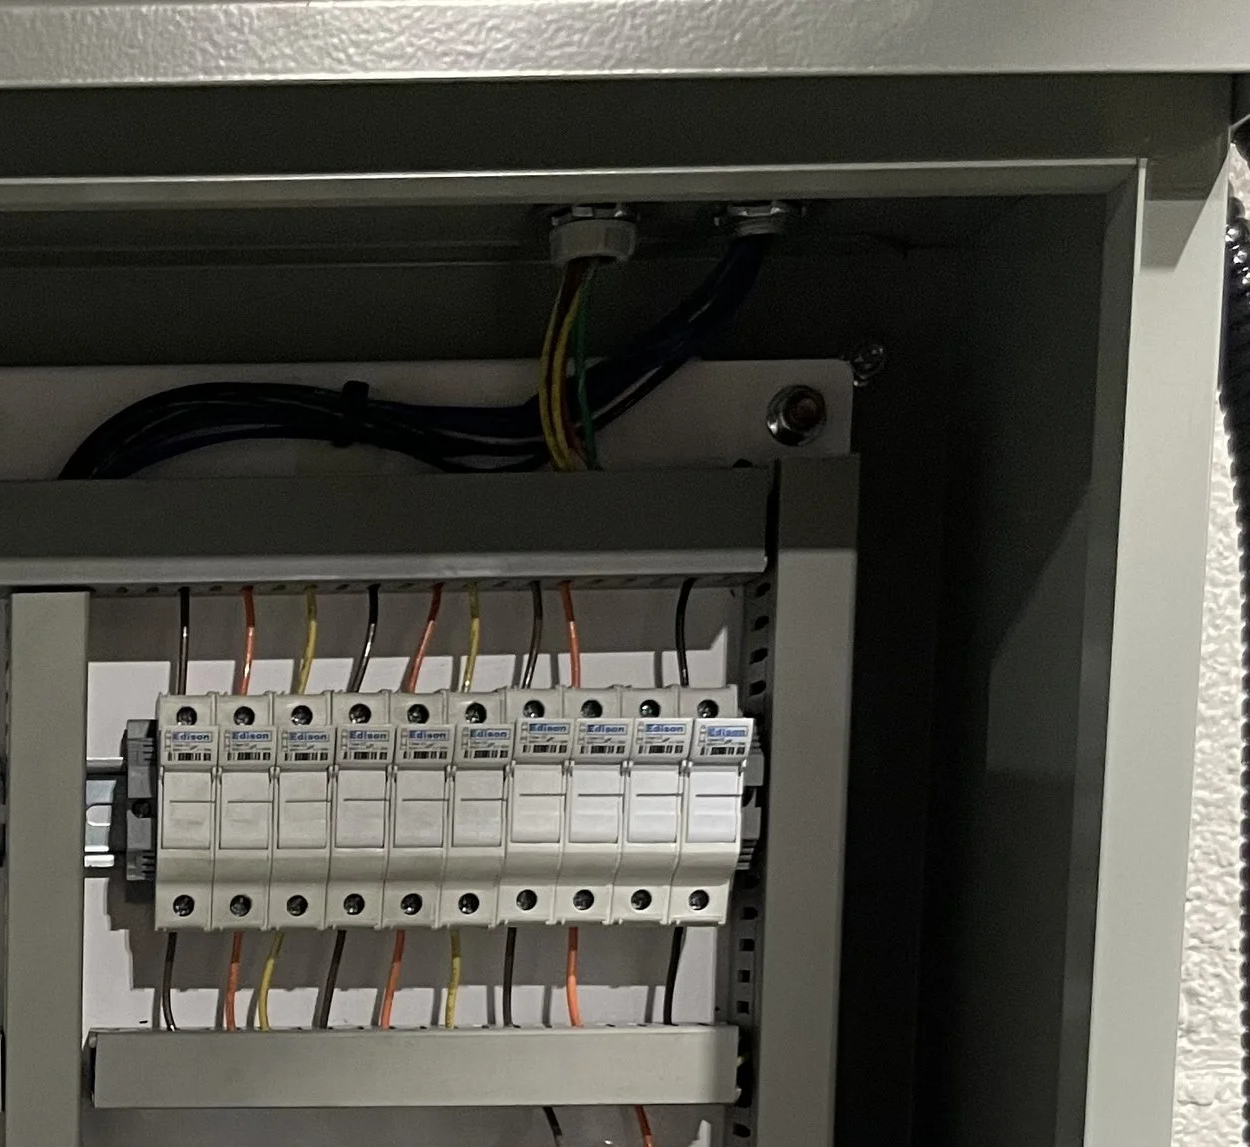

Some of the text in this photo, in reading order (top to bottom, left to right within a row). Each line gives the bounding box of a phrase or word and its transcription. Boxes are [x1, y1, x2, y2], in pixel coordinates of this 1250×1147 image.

[528, 724, 567, 733] Edison
[586, 724, 625, 733] Edison
[645, 724, 684, 733] Edison
[172, 732, 210, 741] Edison
[231, 731, 269, 740] Edison
[289, 732, 327, 741] Edison
[349, 731, 387, 740] Edison
[408, 730, 446, 740] Edison
[470, 730, 508, 738] Edison
